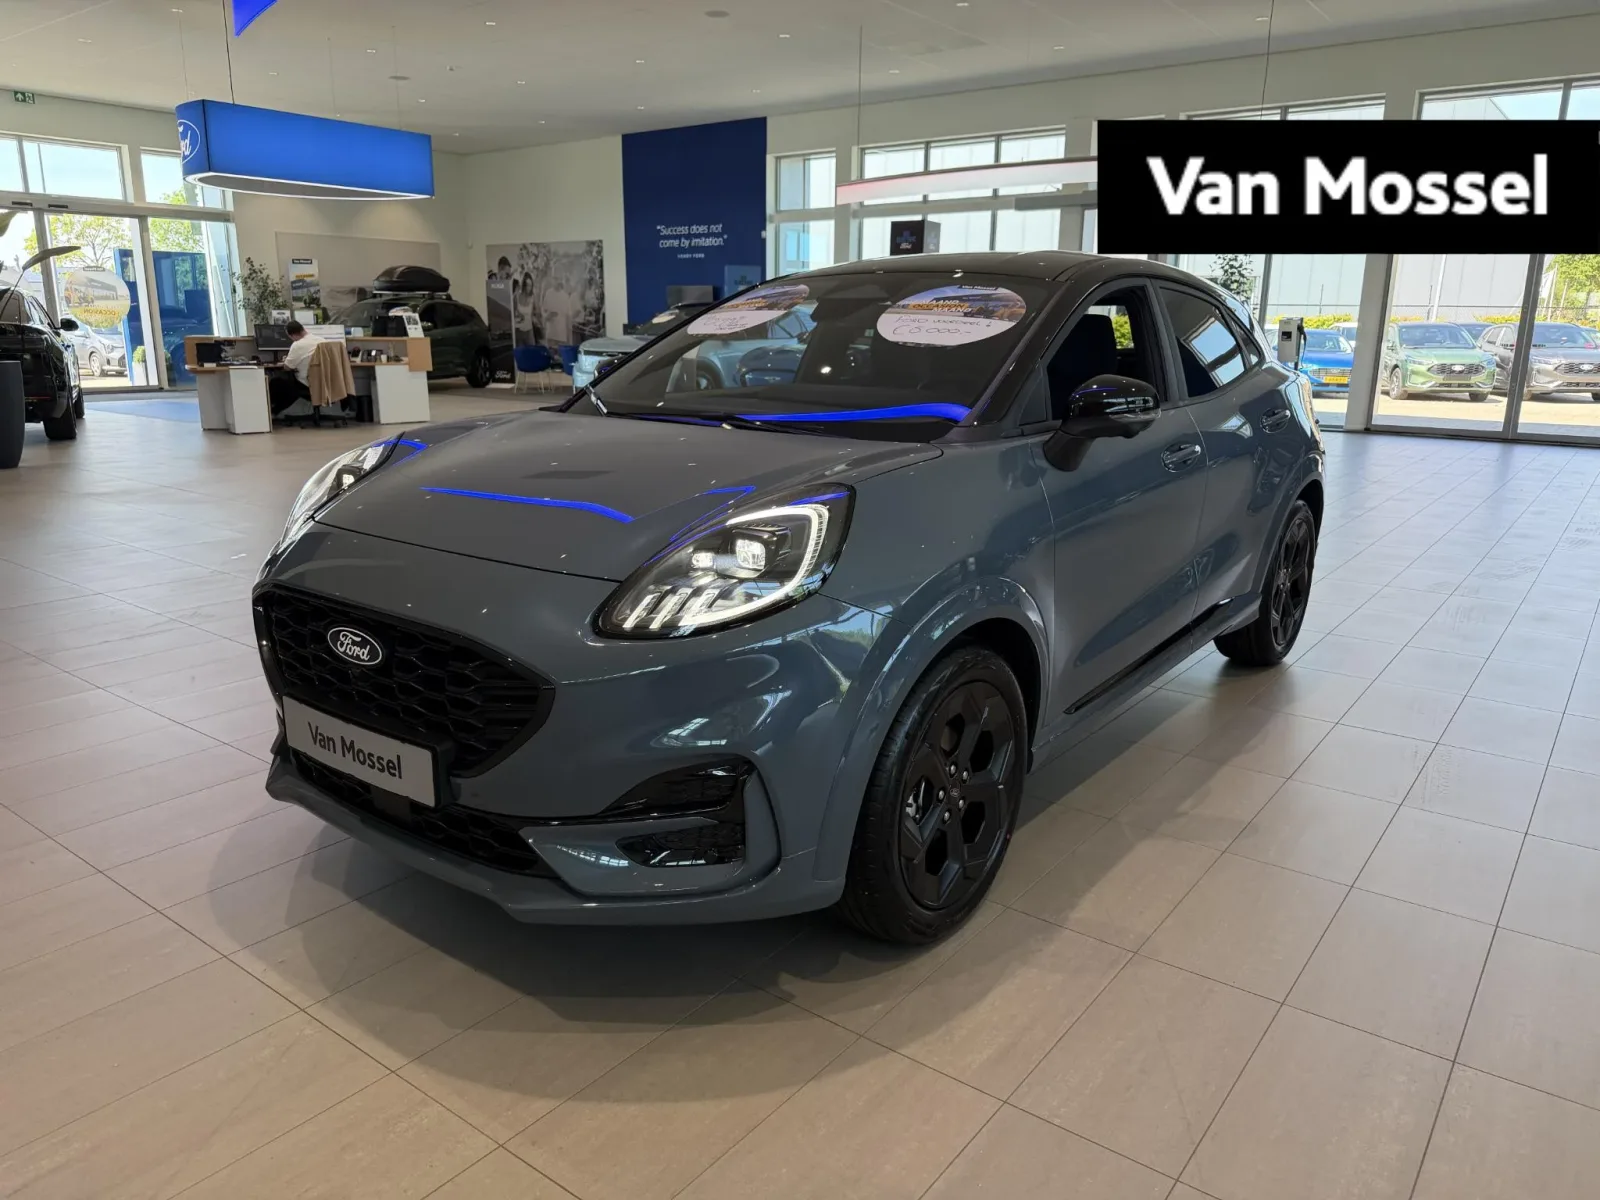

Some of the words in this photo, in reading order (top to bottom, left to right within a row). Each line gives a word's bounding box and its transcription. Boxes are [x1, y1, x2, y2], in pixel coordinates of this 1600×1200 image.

[689, 224, 708, 233] does
[709, 223, 723, 232] not
[659, 239, 680, 248] come
[680, 237, 690, 249] by
[337, 631, 371, 661] Ford
[307, 721, 337, 754] Van
[340, 735, 403, 780] Mossel
